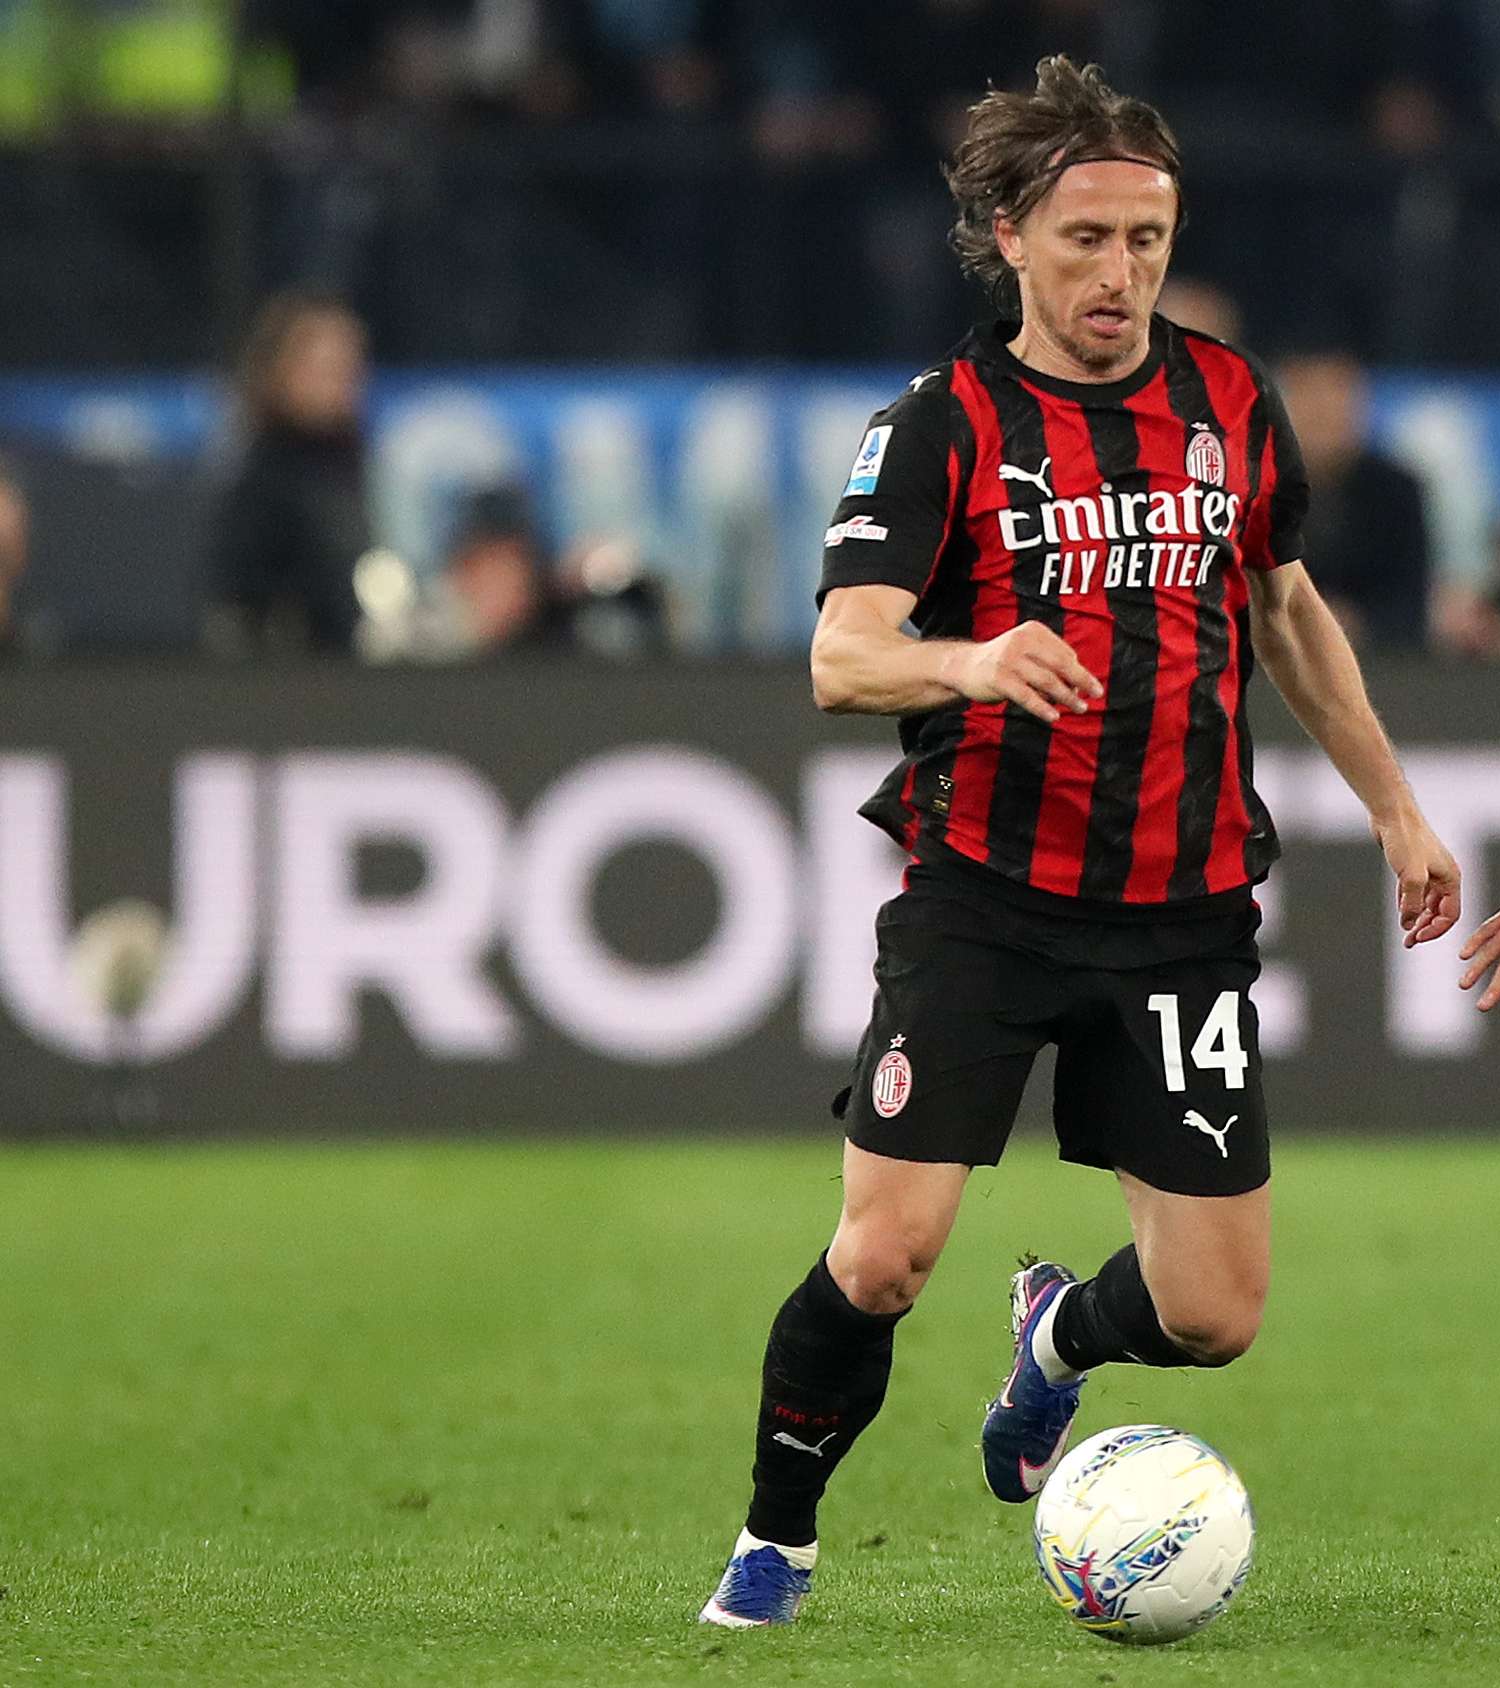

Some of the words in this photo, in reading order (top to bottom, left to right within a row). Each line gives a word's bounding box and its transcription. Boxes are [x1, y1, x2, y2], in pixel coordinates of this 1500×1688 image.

[997, 481, 1241, 551] Emirates
[1040, 549, 1099, 596] FLY
[1103, 542, 1219, 589] BETTER
[1147, 990, 1249, 1092] 14
